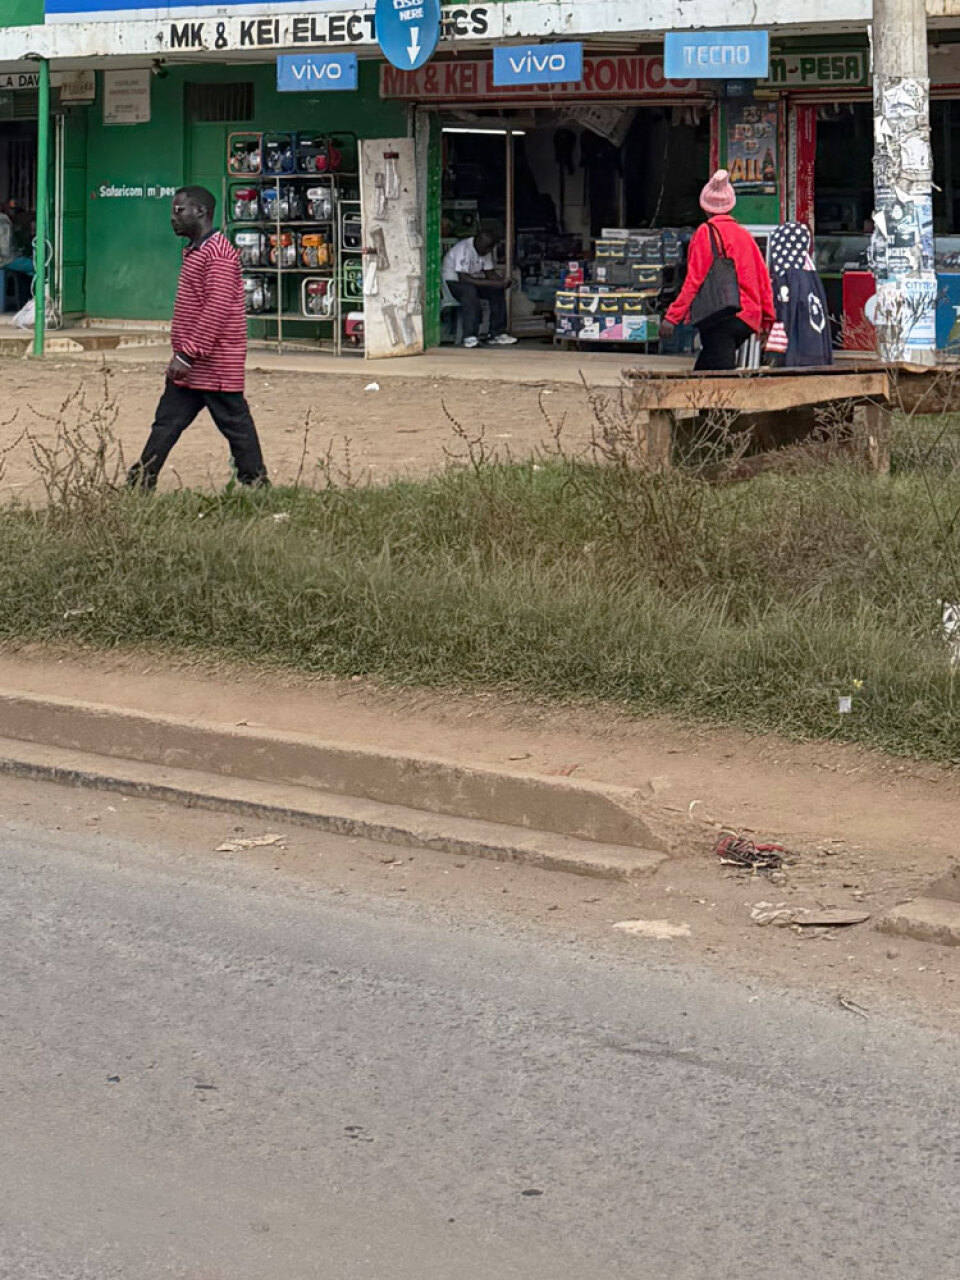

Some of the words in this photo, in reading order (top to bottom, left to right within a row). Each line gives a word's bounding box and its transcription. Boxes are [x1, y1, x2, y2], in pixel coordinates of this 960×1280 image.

[170, 22, 202, 48] MK
[214, 22, 228, 49] &
[240, 19, 279, 46] KEI
[292, 8, 488, 42] ELECTICS
[509, 50, 565, 73] vivo
[683, 45, 750, 65] TECNO
[292, 59, 341, 80] vivo
[383, 66, 420, 94] MK
[423, 65, 440, 93] &
[445, 63, 478, 93] KEI
[99, 184, 142, 197] Safaricom
